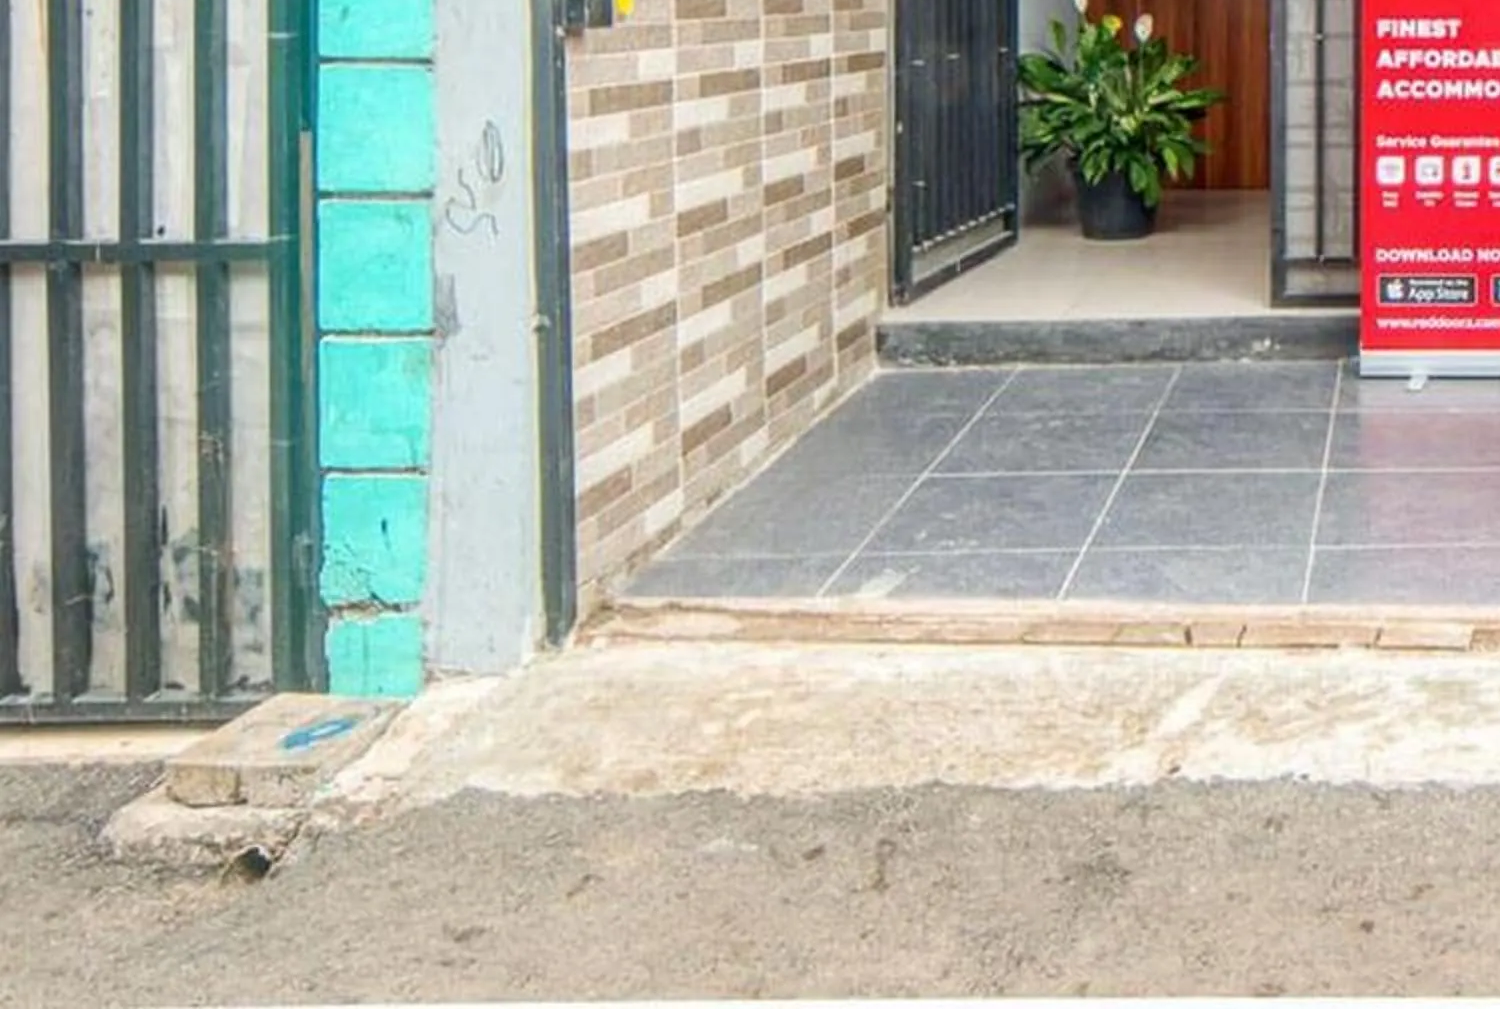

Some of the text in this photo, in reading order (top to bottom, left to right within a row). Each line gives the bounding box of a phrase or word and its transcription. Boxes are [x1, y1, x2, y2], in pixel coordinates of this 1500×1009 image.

[1376, 19, 1461, 39] FINEST
[1376, 134, 1427, 148] Service
[1376, 248, 1474, 263] DOWNLOAD
[1408, 287, 1434, 303] App
